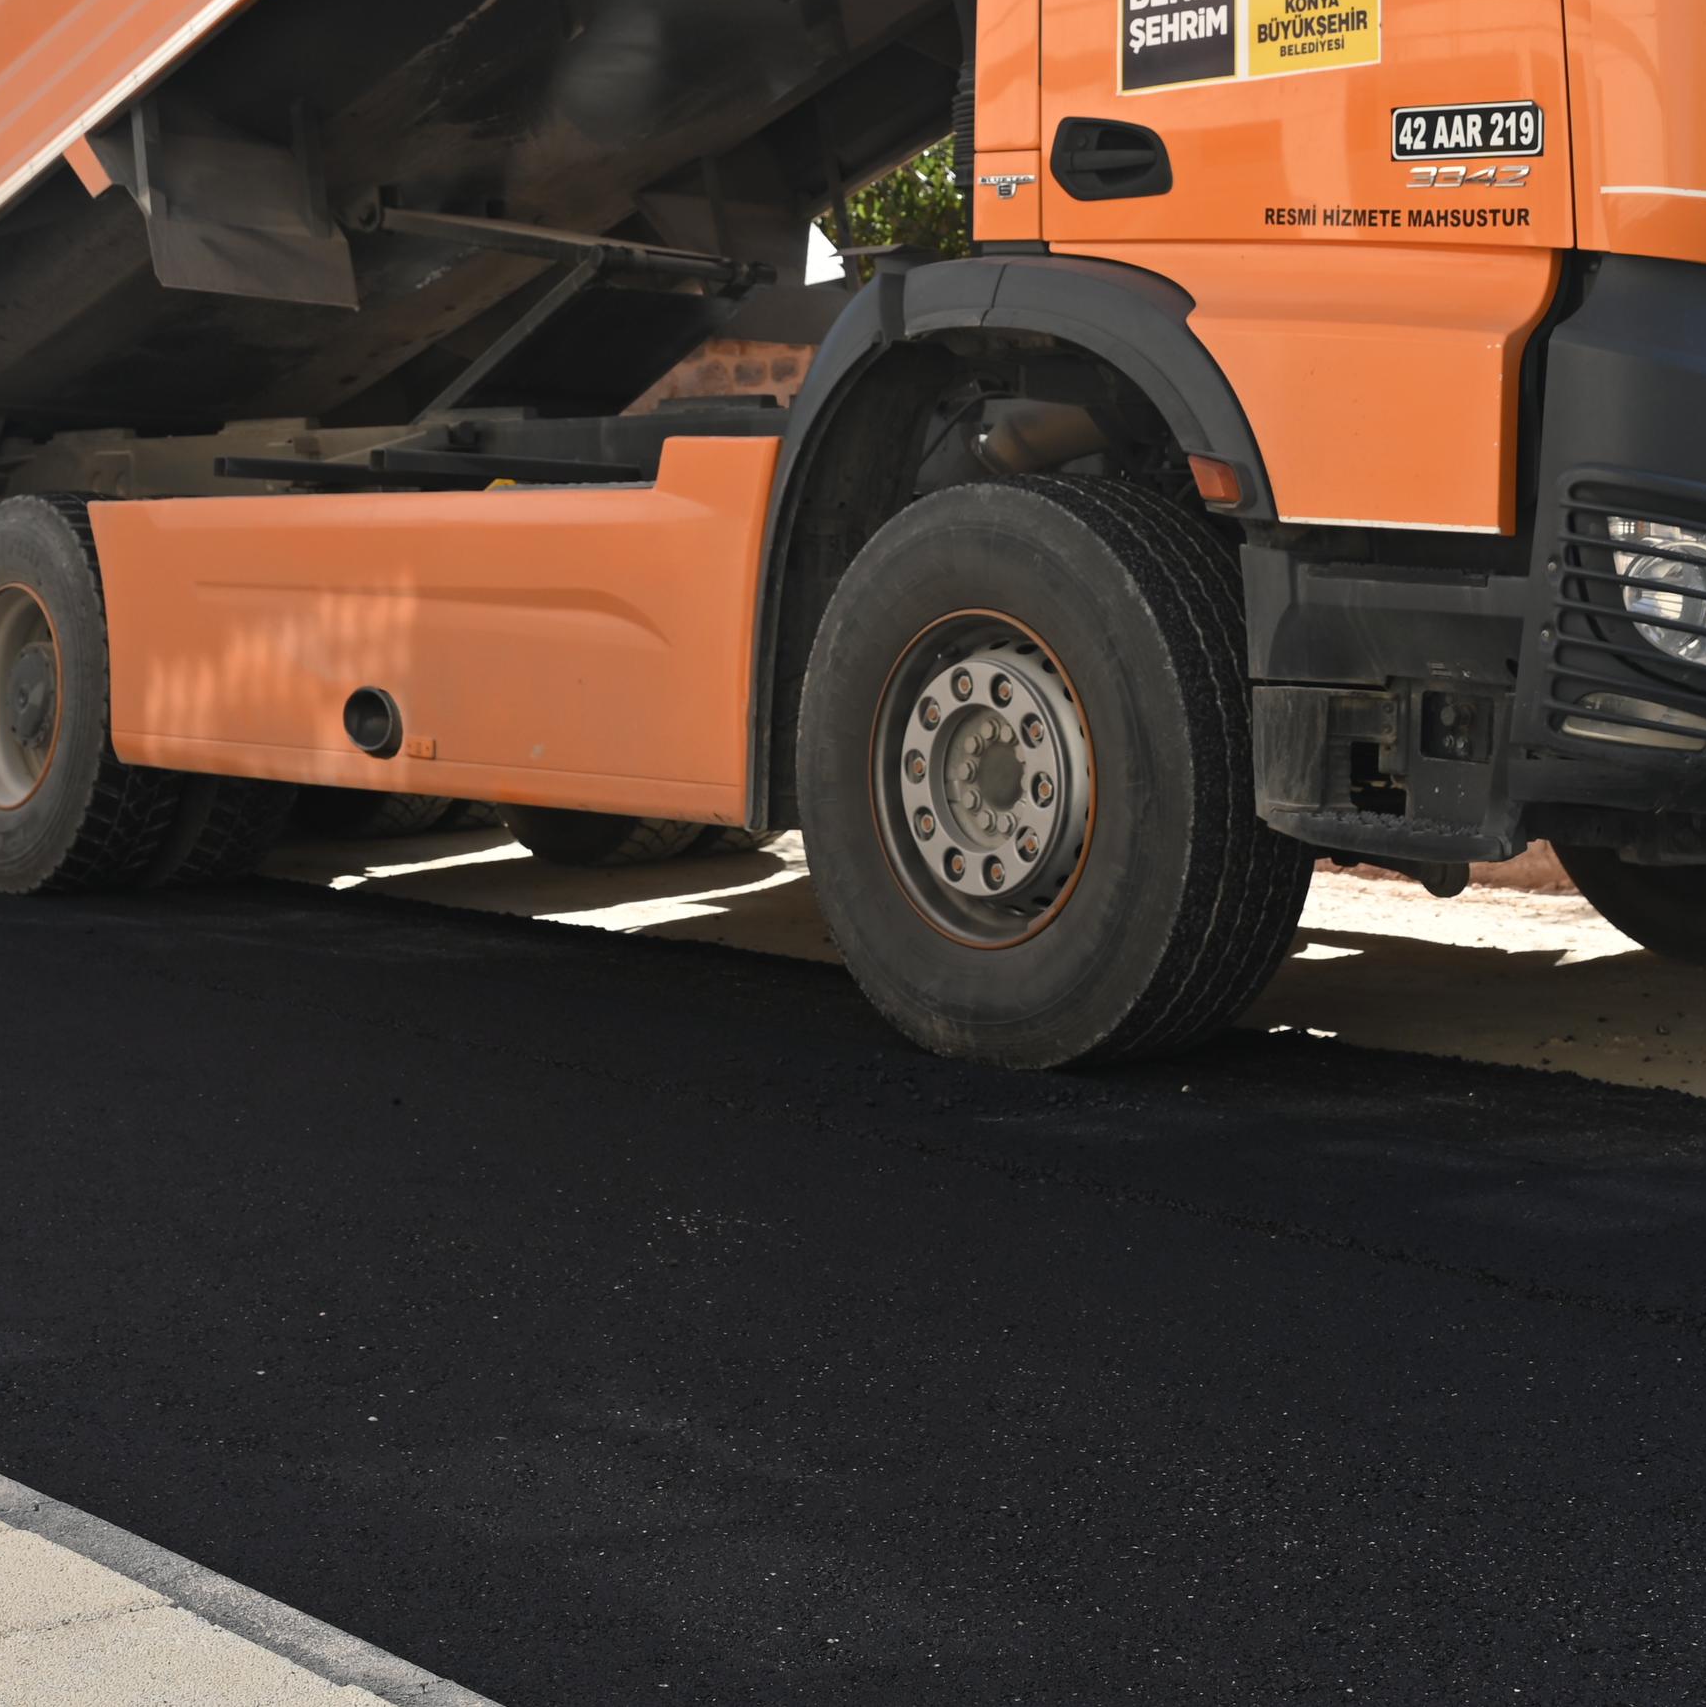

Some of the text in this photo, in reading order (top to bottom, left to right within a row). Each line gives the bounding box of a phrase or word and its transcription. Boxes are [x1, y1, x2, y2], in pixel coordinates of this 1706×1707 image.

[1257, 6, 1368, 44] BÜYÜKŞEHİR
[1280, 35, 1345, 57] BELEDİYESİ
[1399, 110, 1535, 151] 42 AAR 219
[1406, 165, 1531, 189] 3342
[1264, 204, 1530, 228] RESMİ HİZMETE MAHSUSTUR
